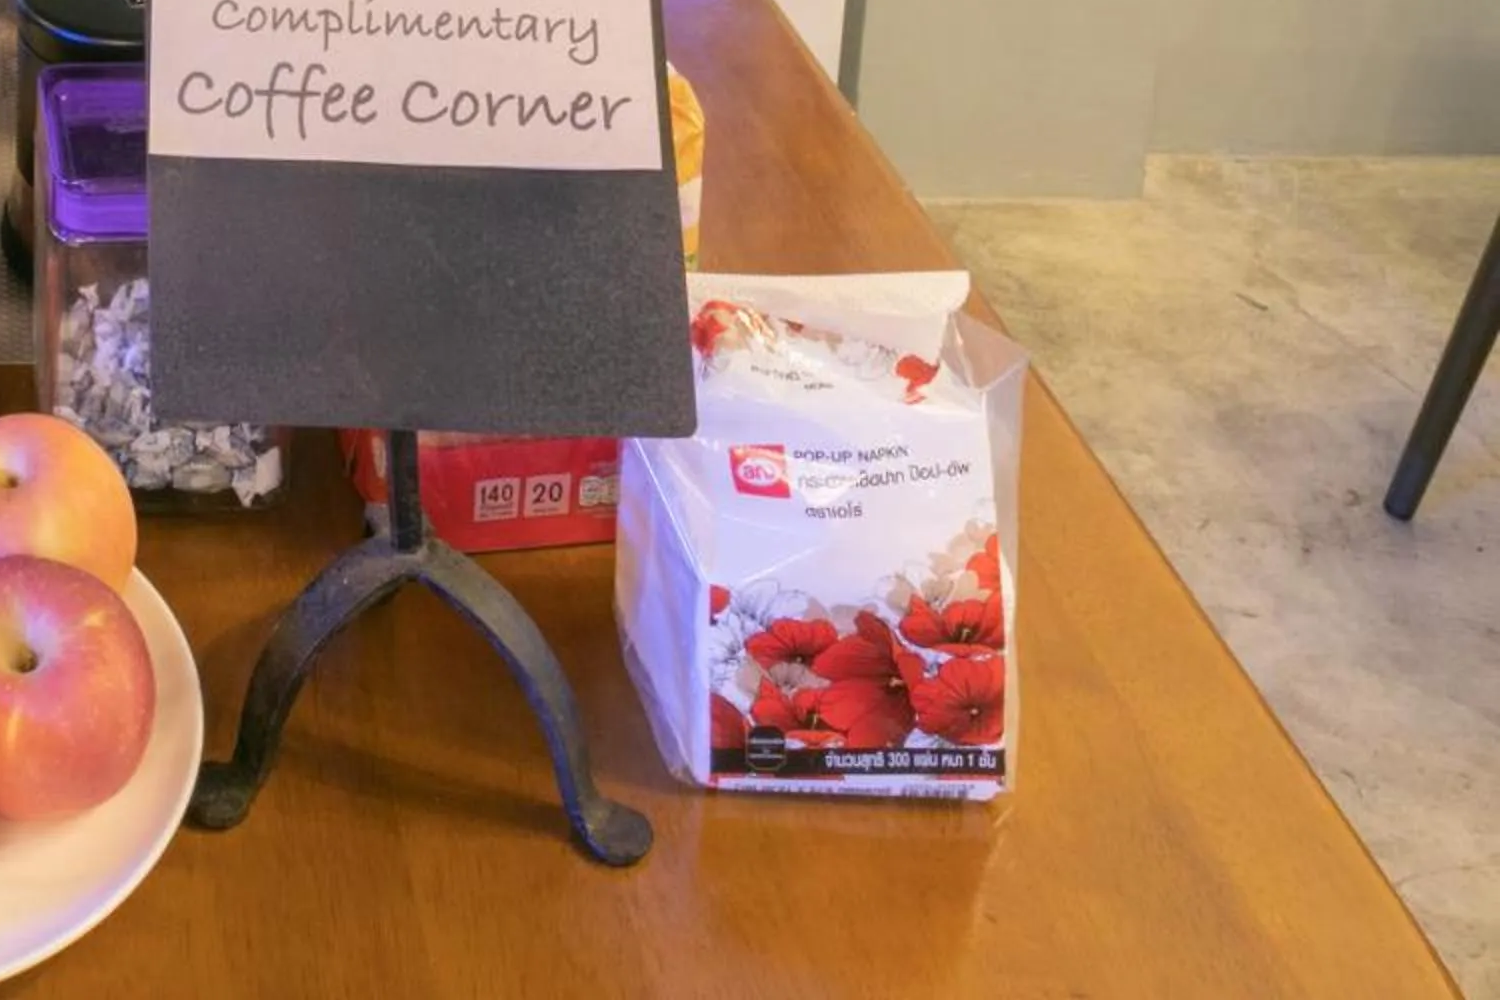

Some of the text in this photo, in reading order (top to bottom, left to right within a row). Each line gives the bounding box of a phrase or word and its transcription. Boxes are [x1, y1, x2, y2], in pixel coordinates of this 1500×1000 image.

[176, 61, 633, 140] Coffee Corner
[793, 445, 909, 465] POP-UP NAPKIN
[480, 483, 514, 505] 140
[532, 481, 564, 505] 20
[887, 752, 911, 767] 300
